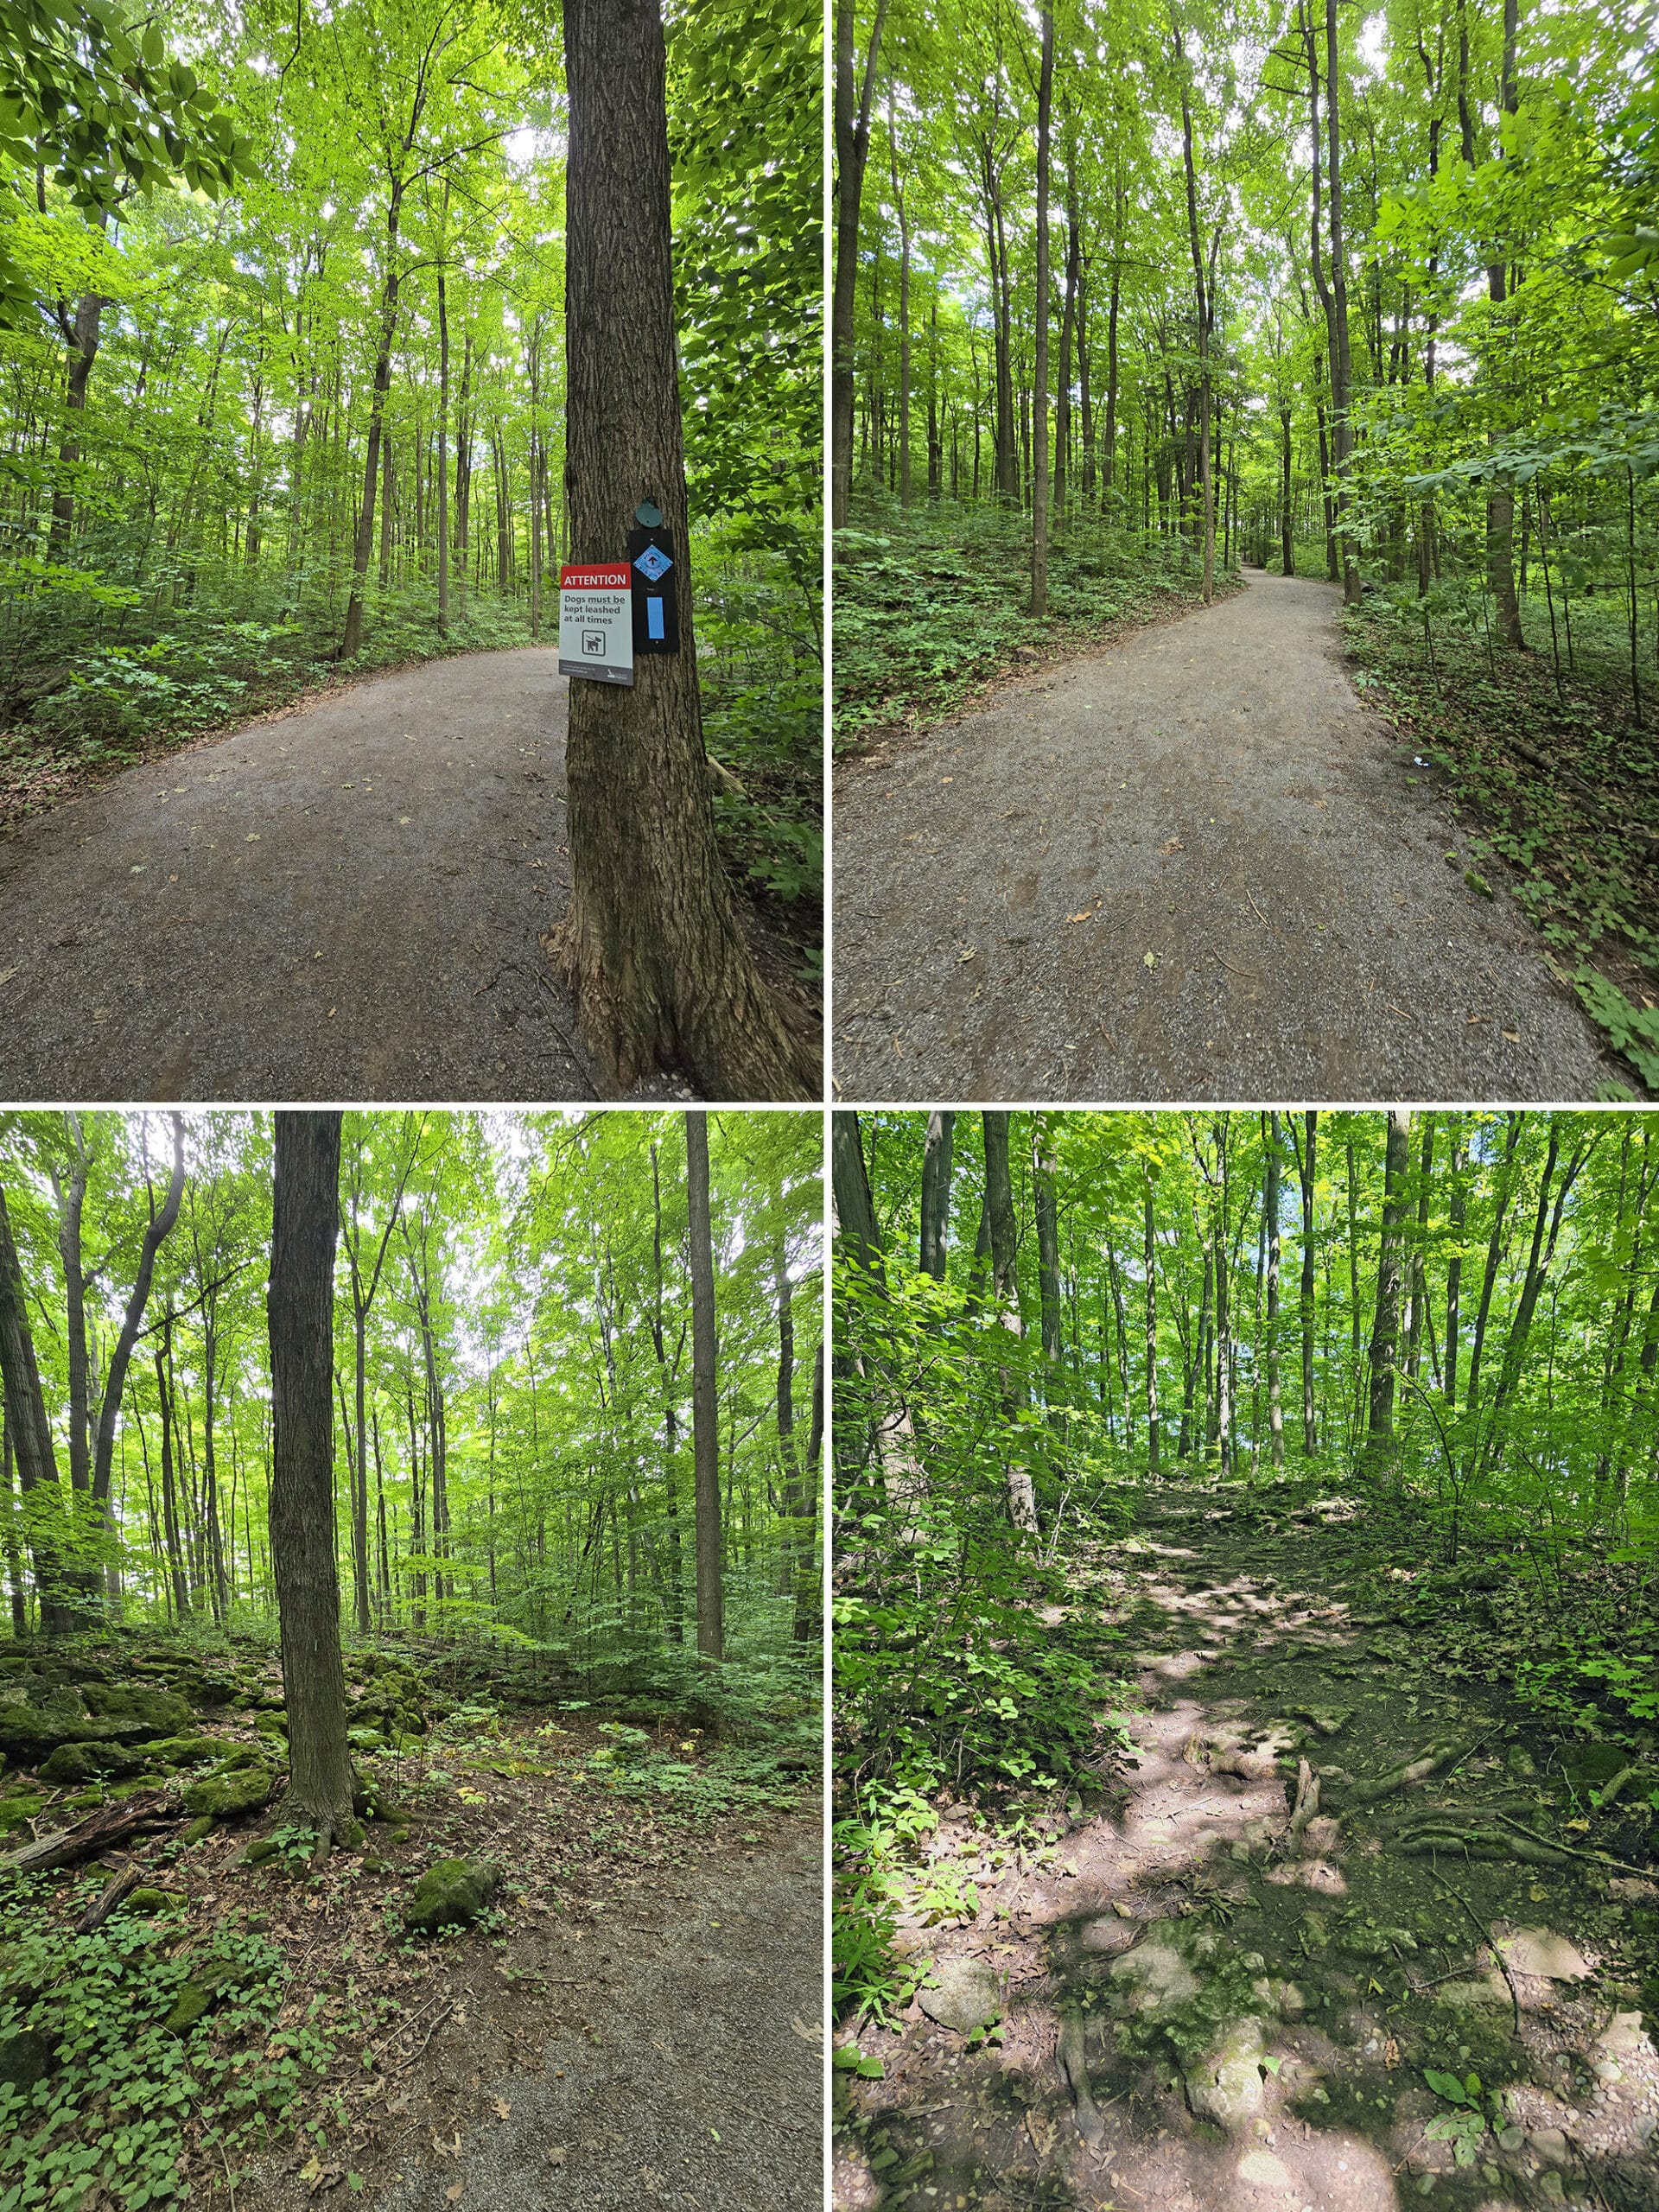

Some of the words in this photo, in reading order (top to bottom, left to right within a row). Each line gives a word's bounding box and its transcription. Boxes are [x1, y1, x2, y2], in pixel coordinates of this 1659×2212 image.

[564, 575, 626, 585] ATTENTION
[565, 595, 586, 604] Dogs
[564, 605, 583, 614] kept
